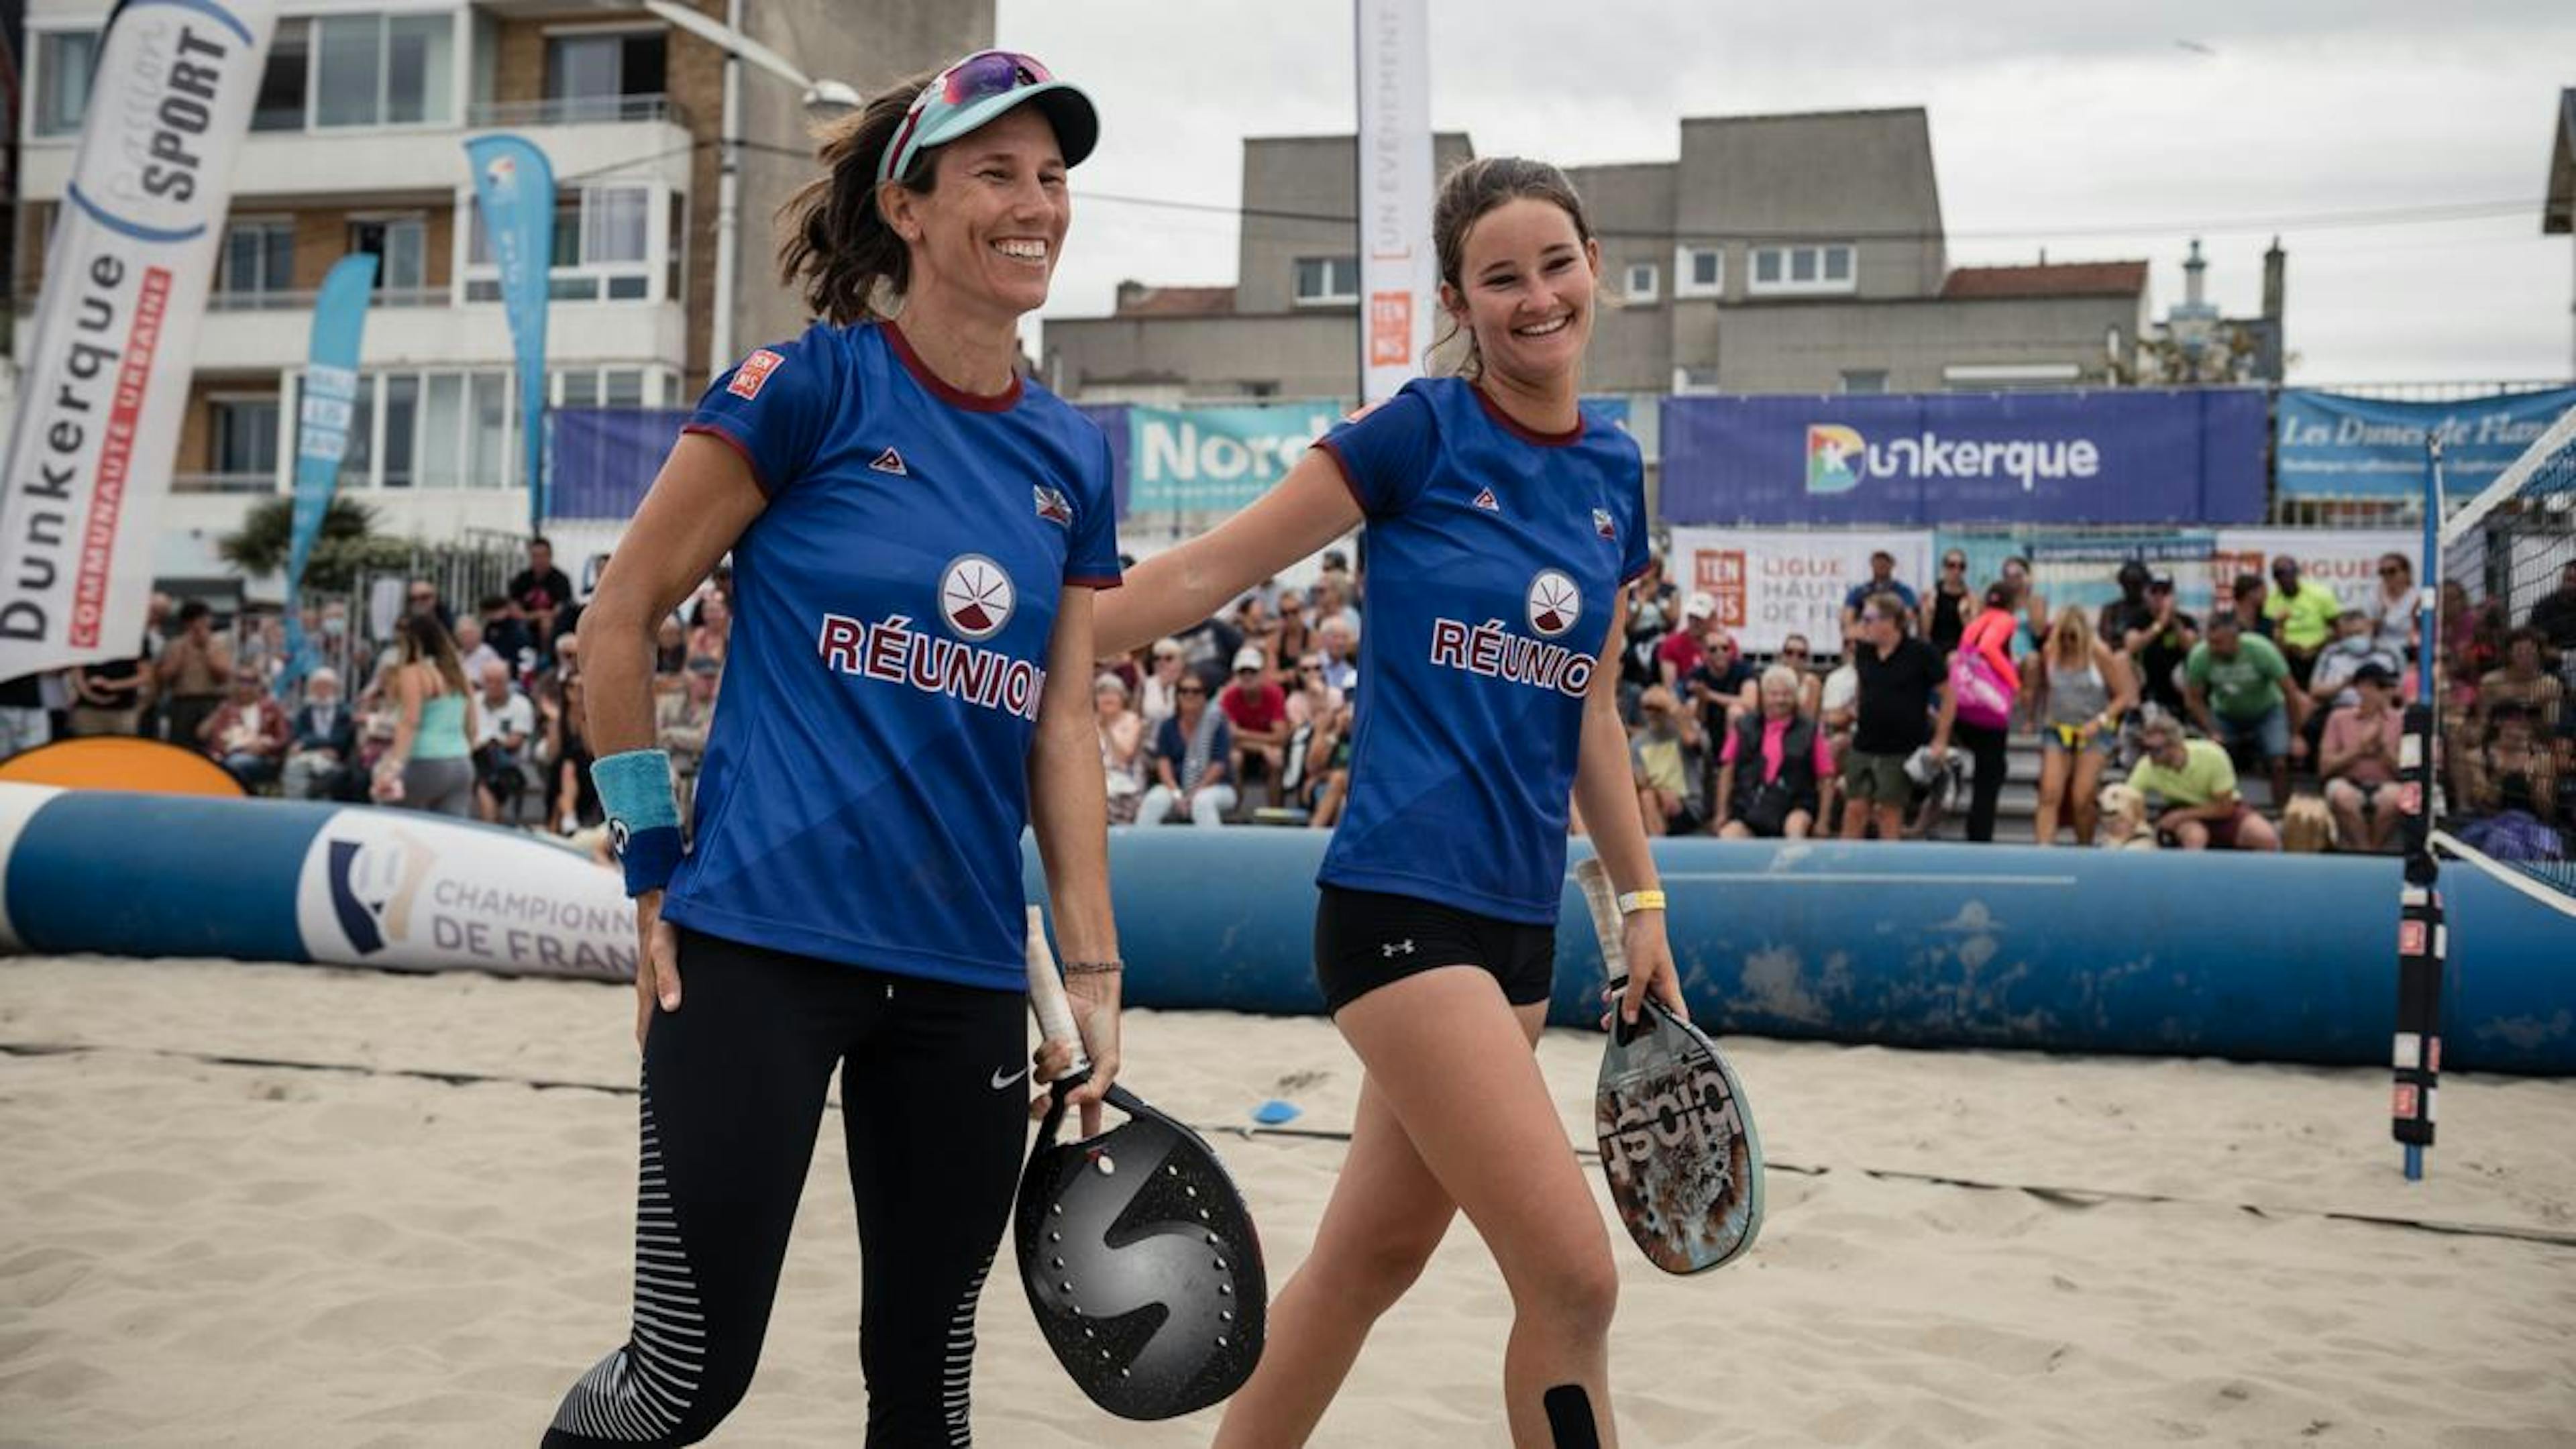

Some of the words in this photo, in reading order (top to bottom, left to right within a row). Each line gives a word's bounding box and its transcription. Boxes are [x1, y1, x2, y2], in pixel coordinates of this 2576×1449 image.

[141, 25, 227, 203] SPORT
[0, 253, 125, 643] Dunkerque
[1806, 423, 2098, 492] Dunkerque
[1763, 559, 1845, 578] LIGUE
[433, 914, 494, 957] DE
[506, 929, 637, 971] FRAN
